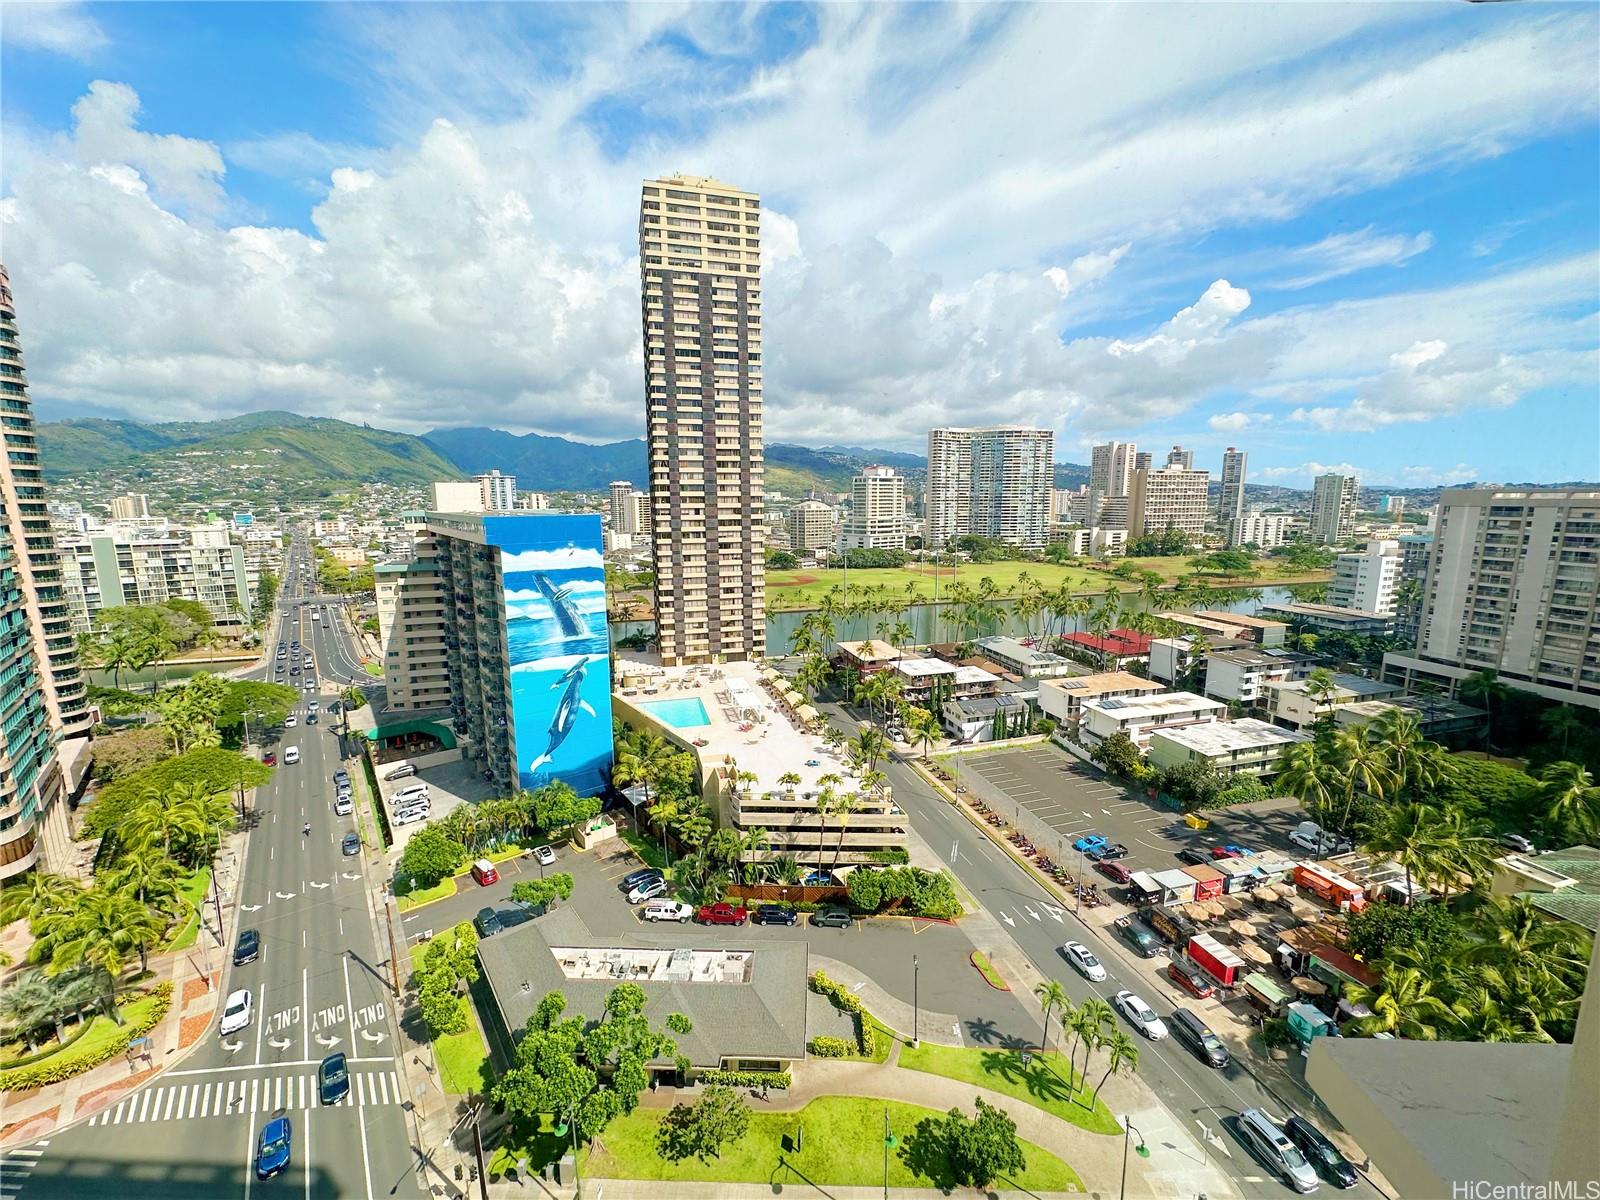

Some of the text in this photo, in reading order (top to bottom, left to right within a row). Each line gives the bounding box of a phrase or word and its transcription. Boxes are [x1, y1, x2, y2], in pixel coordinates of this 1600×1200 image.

[265, 1006, 300, 1036] ONLY
[311, 1004, 345, 1033] ONLY
[354, 1002, 385, 1030] ONLY
